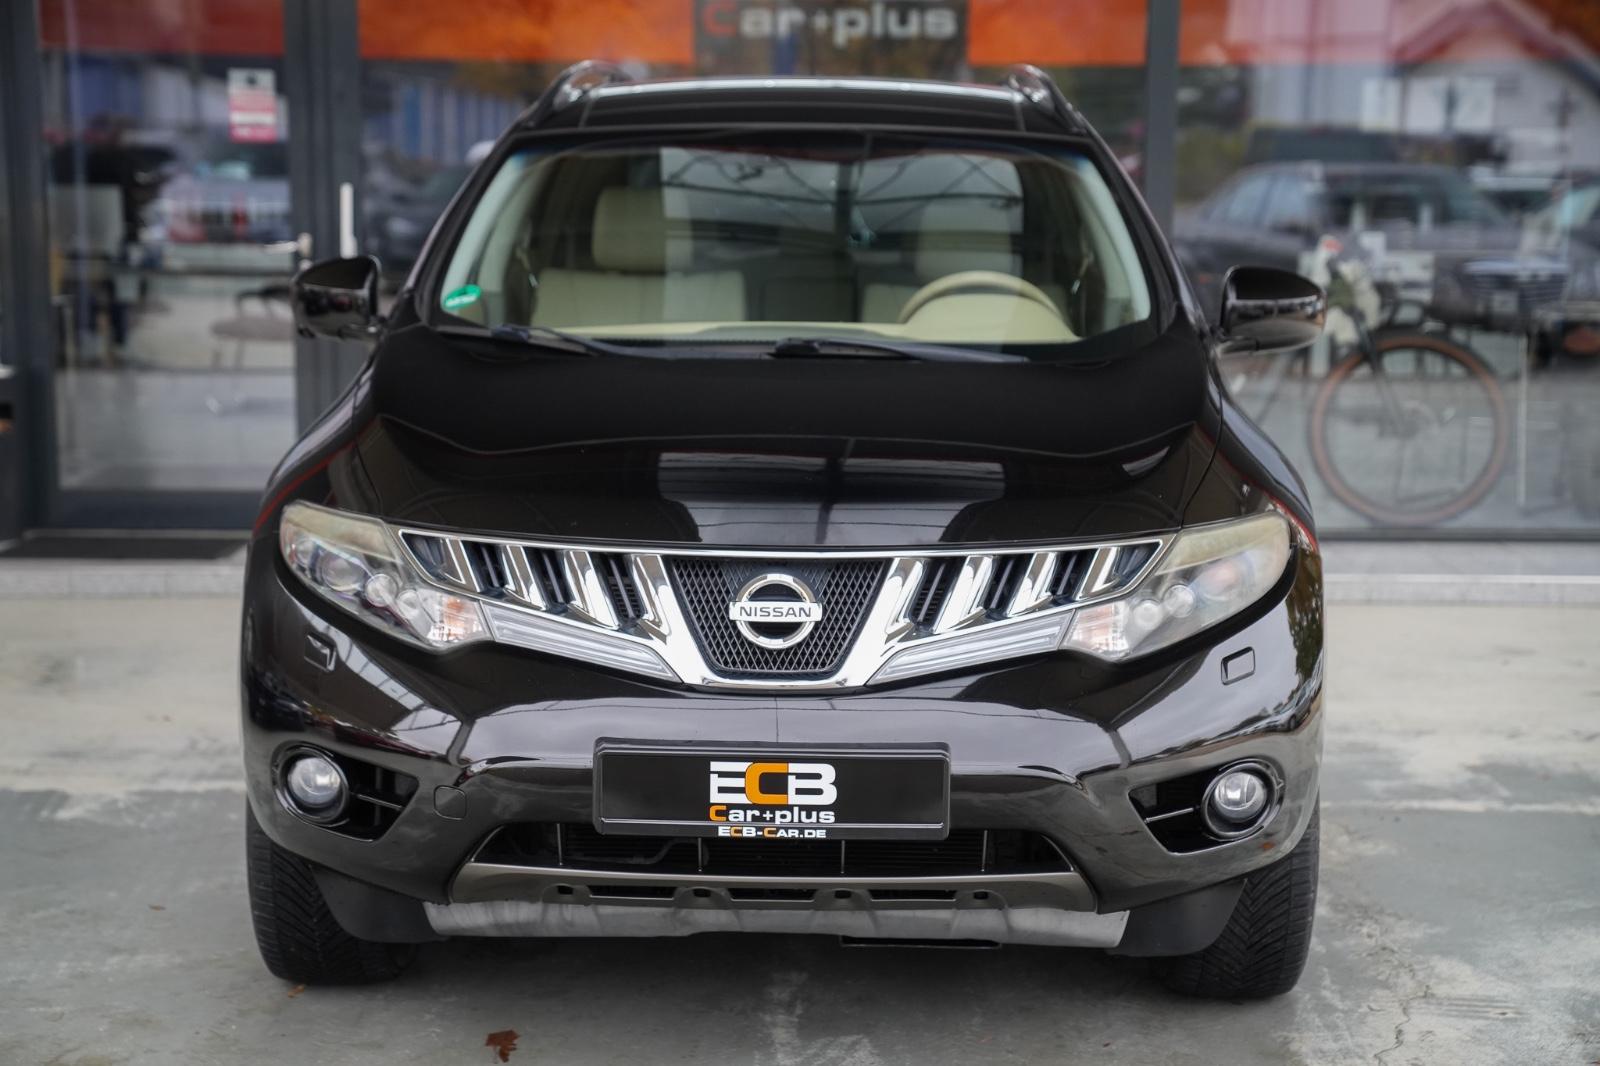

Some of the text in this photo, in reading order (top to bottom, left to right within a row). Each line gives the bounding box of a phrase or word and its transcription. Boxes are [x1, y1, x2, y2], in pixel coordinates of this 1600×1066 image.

[703, 1, 957, 48] Car+plus
[739, 606, 812, 618] NISSAN
[709, 761, 838, 806] ECB
[709, 805, 836, 824] Car+plus
[718, 826, 827, 838] ECB-CAR.DE
